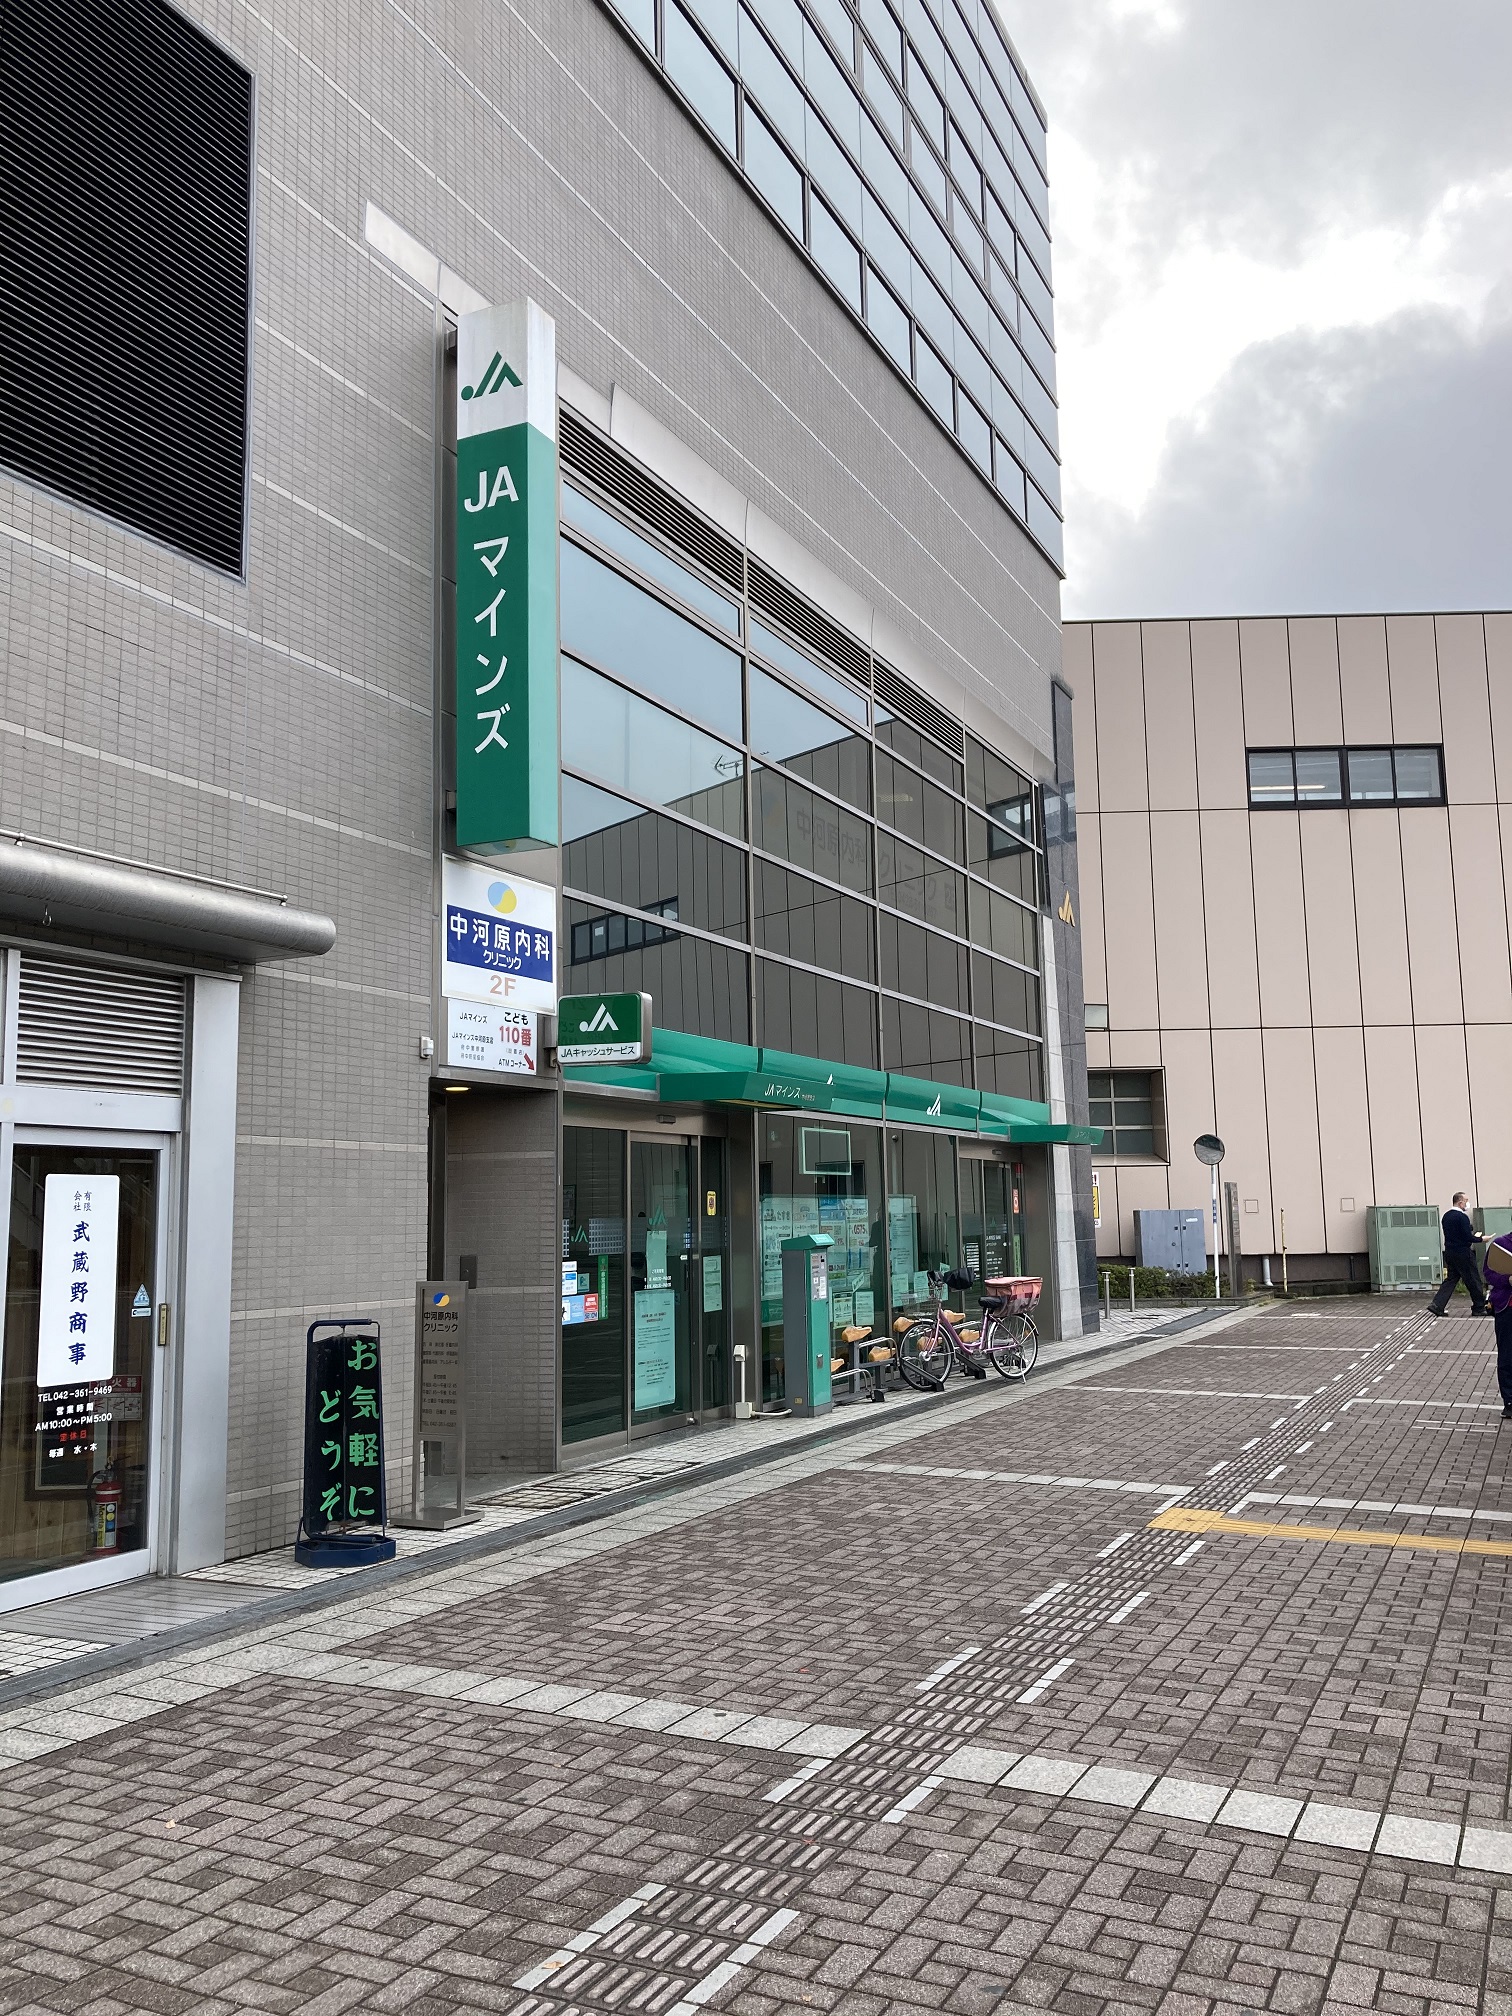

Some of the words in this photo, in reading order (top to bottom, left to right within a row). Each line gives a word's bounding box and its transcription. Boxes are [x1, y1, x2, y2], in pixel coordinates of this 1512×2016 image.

[450, 912, 550, 962] 中河原内科
[483, 949, 522, 970] クリニック
[489, 974, 517, 996] 2F
[460, 1012, 488, 1024] JAマインズ
[504, 1011, 529, 1025] こども
[499, 1025, 532, 1047] 110番
[560, 1045, 635, 1058] JAキャッシュサービス
[68, 1220, 91, 1365] 武蔵野商事
[423, 1311, 459, 1321] 中河原内科
[423, 1323, 459, 1333] クリニック
[58, 1429, 88, 1442] 定休日
[347, 1339, 380, 1516] お気軽に
[319, 1389, 341, 1521] どうぞ
